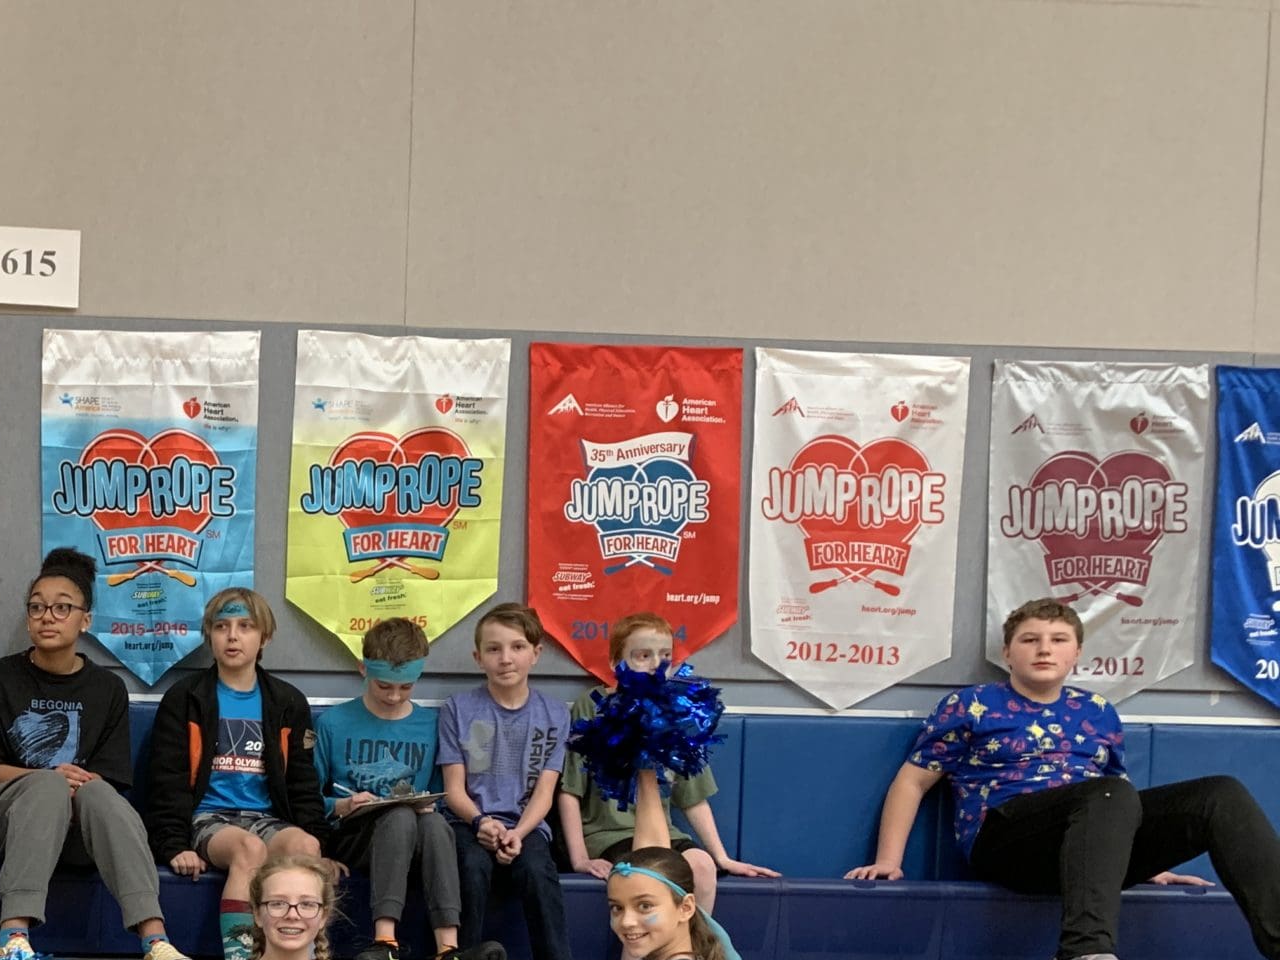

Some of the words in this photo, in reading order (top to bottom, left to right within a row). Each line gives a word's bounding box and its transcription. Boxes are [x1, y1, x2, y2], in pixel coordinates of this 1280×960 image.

[1, 248, 56, 277] 615
[455, 401, 476, 409] Heart
[682, 397, 717, 406] American
[682, 405, 709, 415] Heart
[590, 448, 614, 462] 35th
[616, 442, 685, 461] Anniversary
[54, 459, 149, 517] JUMP
[149, 457, 235, 517] ROPE
[302, 461, 396, 516] JUMP
[397, 455, 483, 516] ROPE
[566, 479, 638, 522] JUMP
[639, 479, 708, 523] ROPE
[761, 466, 856, 524] JUMP
[856, 467, 945, 527] ROPE
[1001, 481, 1097, 539] JUMP
[1098, 478, 1187, 540] ROPE
[206, 530, 220, 539] SM
[452, 521, 468, 530] SM
[683, 531, 696, 539] SM
[108, 534, 140, 557] FOR
[144, 534, 197, 559] HEART
[352, 534, 384, 555] FOR
[387, 531, 443, 553] HEART
[606, 535, 634, 553] FOR
[636, 534, 677, 555] HEART
[813, 543, 847, 565] FOR
[850, 543, 907, 571] HEART
[554, 572, 588, 582] SUBWAY
[1053, 557, 1088, 581] FOR
[1091, 556, 1148, 581] HEART
[666, 593, 720, 604] heart.org/jump
[861, 605, 917, 616] heart.org/jump
[111, 622, 188, 637] 2015-2016
[124, 640, 174, 651] heart.org/jump
[785, 640, 901, 666] 2012-2013
[1071, 656, 1145, 676] 1-2012
[1255, 659, 1280, 680] 20
[31, 699, 83, 711] BEGONIA
[245, 740, 262, 751] 20
